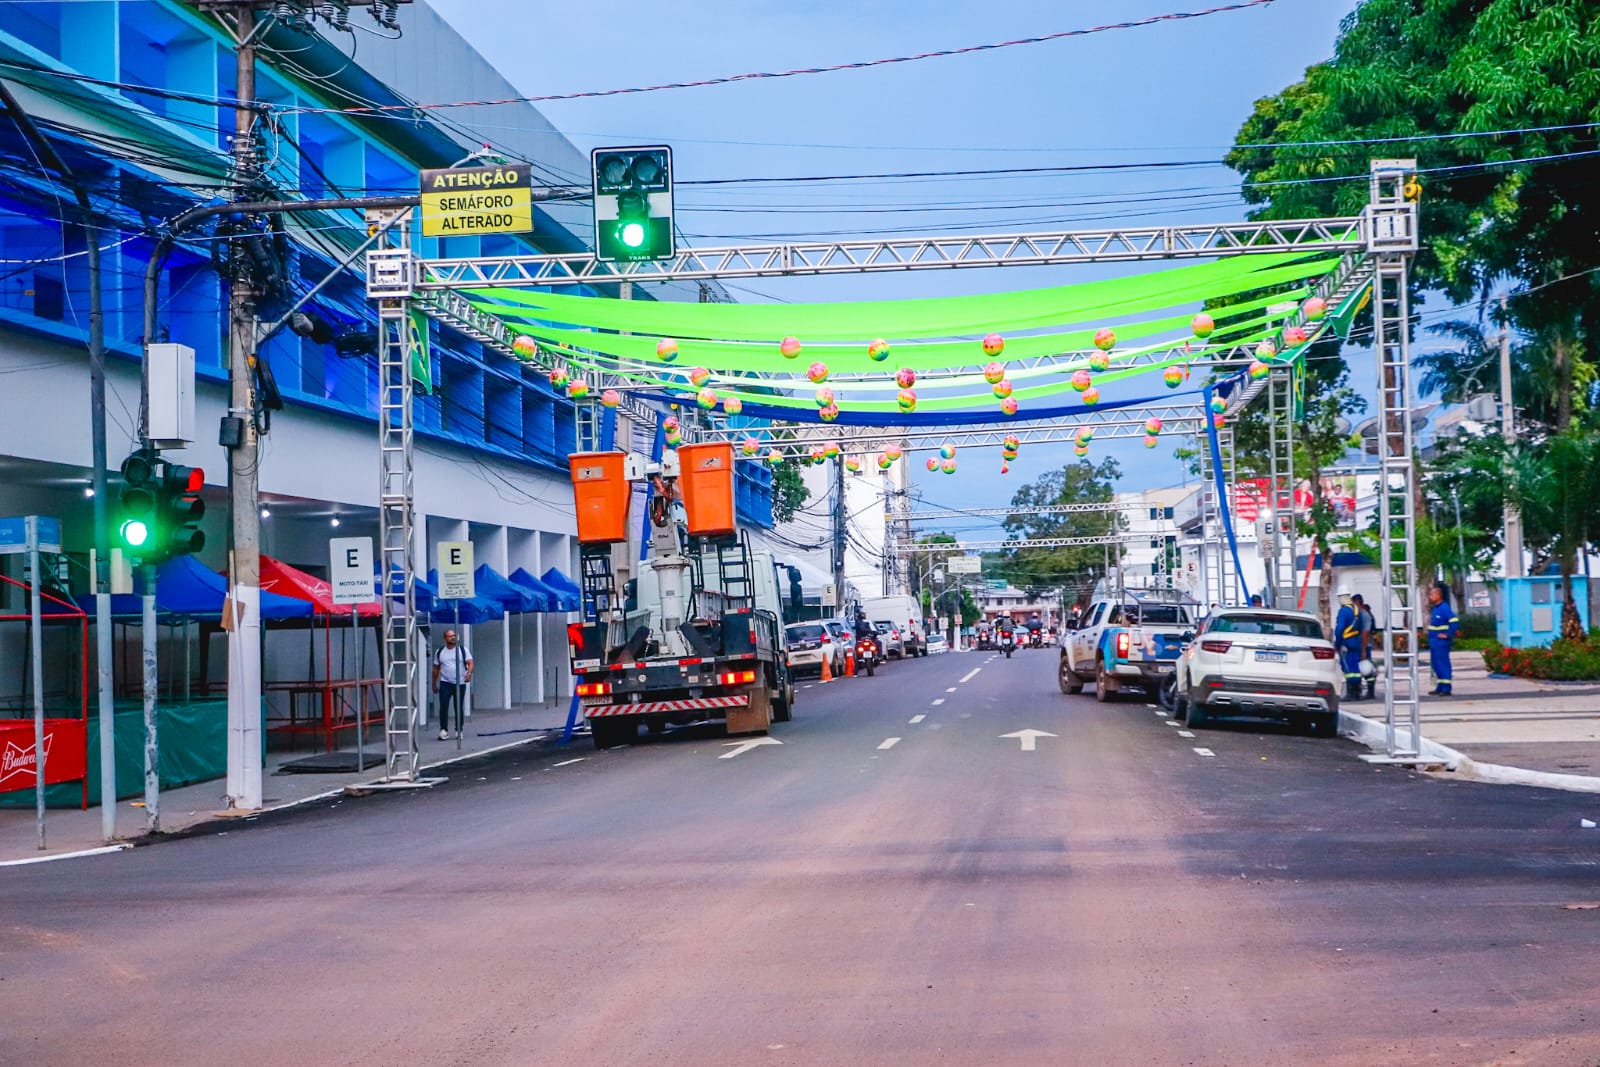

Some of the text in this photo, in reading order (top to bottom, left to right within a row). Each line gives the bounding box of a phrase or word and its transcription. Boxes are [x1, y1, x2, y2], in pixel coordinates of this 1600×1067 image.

[433, 169, 519, 188] ATENÇÃO
[439, 194, 513, 211] SEMÁFORO
[441, 214, 513, 230] ALTERADO
[346, 548, 359, 568] E
[450, 548, 461, 565] E
